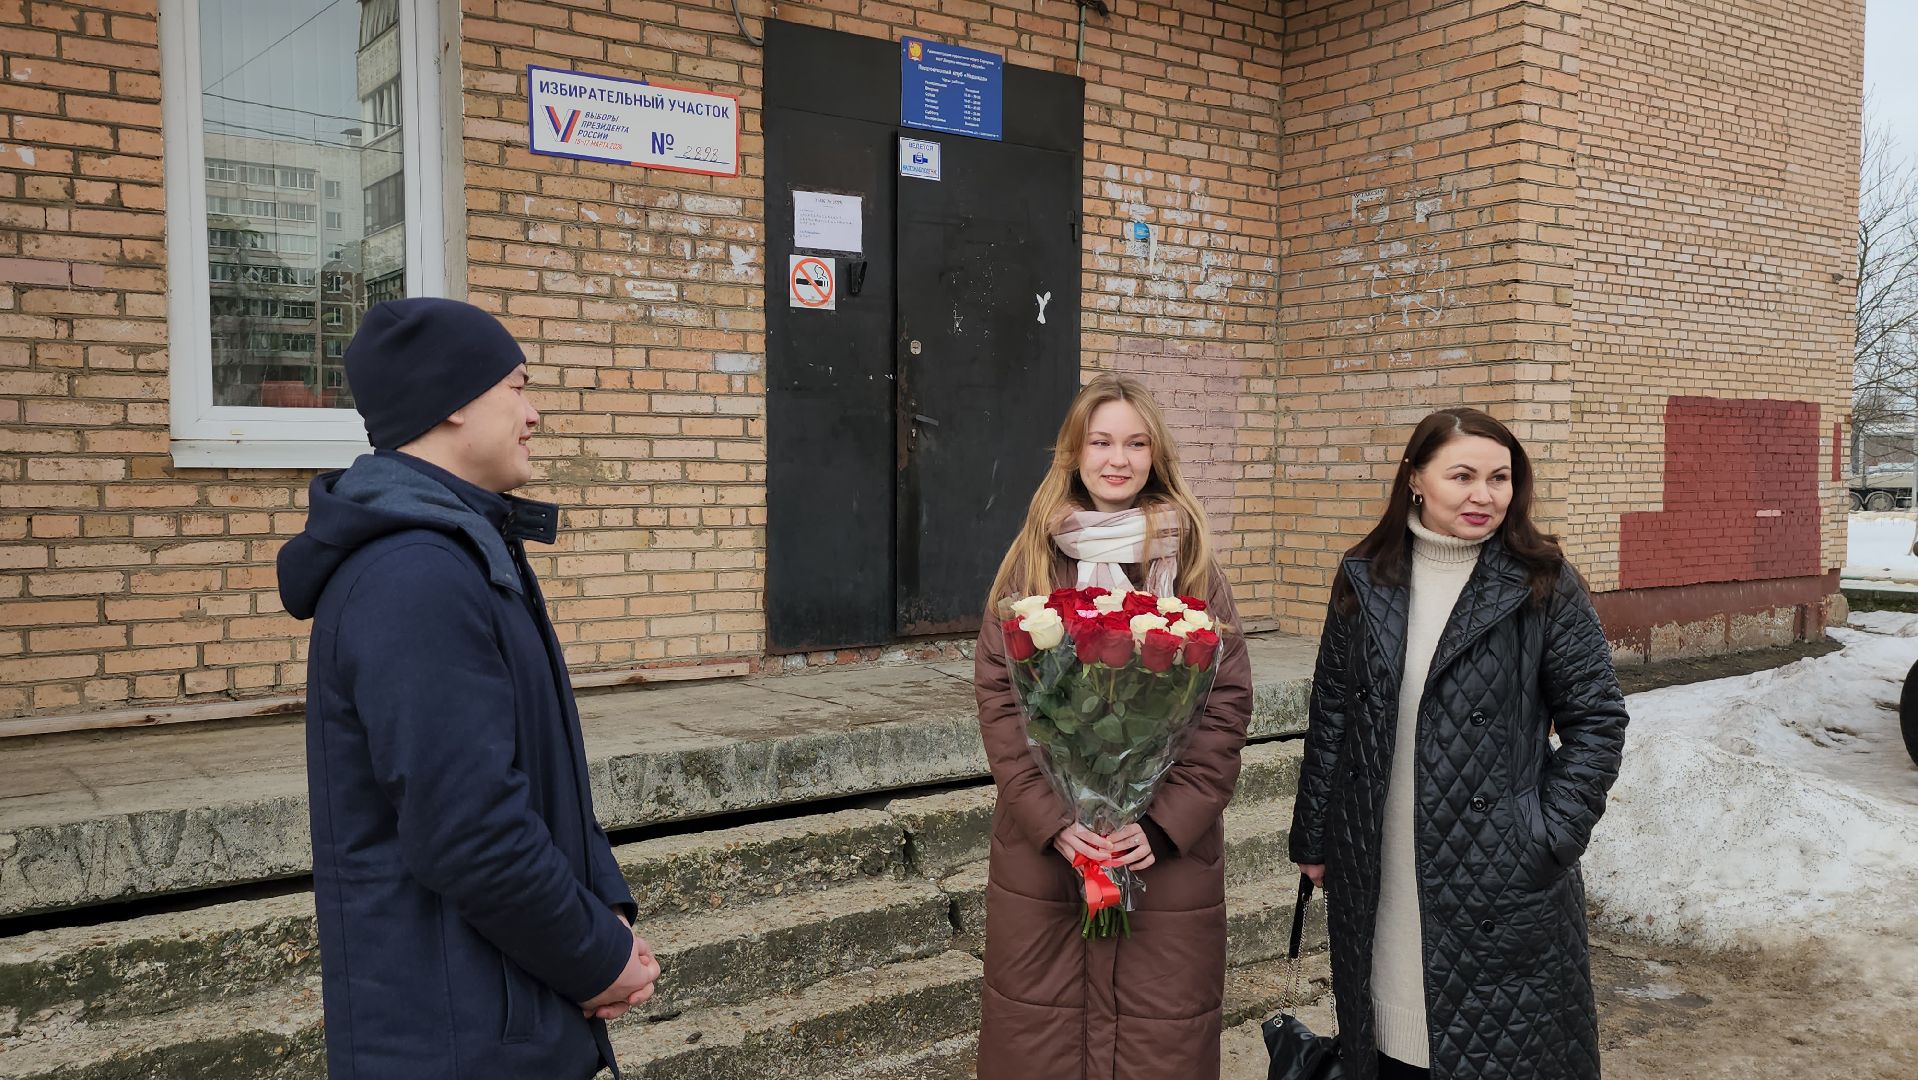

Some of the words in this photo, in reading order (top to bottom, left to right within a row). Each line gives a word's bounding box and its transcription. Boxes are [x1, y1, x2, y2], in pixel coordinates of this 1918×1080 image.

[539, 81, 664, 109] ИЗБИРАТЕЛЬНЫЙ
[669, 99, 729, 119] УЧАСТОК
[584, 111, 619, 123] ВЫБОРЫ
[581, 120, 630, 134] ПРЕЗИДЕНТА
[577, 129, 609, 141] РОССИИ
[590, 140, 609, 149] МАРТА
[651, 131, 674, 155] №
